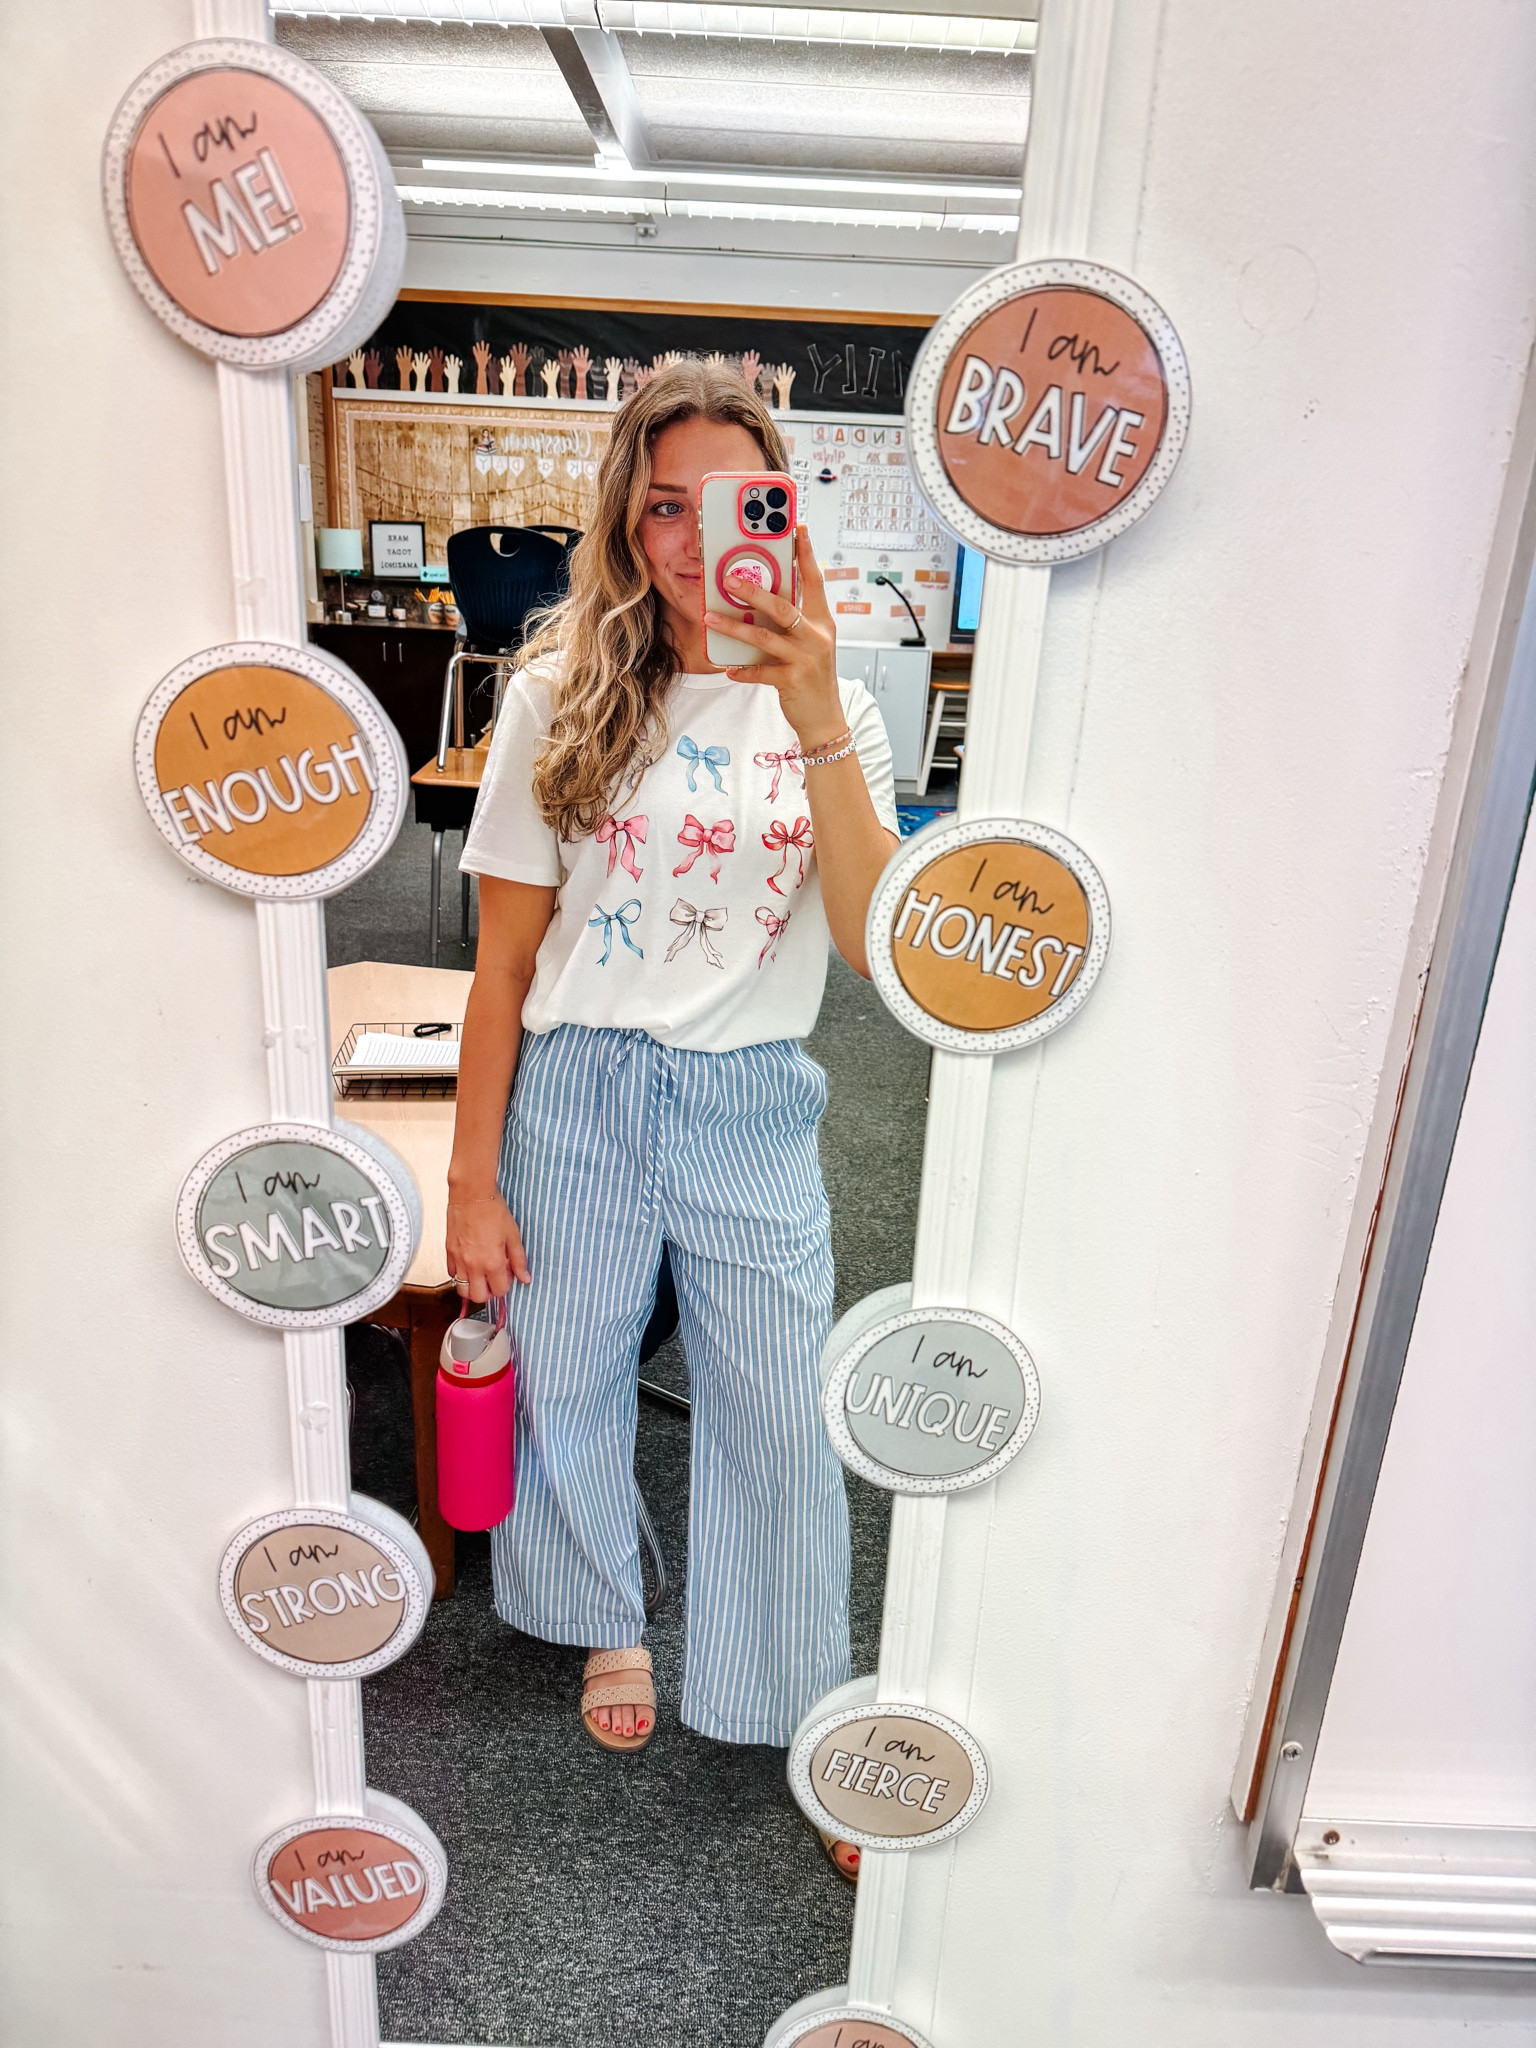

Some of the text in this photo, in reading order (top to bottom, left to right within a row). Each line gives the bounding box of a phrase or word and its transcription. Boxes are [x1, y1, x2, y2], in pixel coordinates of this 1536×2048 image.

[157, 111, 257, 179] I am
[181, 147, 303, 276] ME!
[1019, 307, 1120, 376] I am
[944, 354, 1145, 488] BRAVE
[190, 707, 286, 749] I am
[161, 733, 379, 845] ENOUGH
[969, 858, 1055, 915] I am
[892, 887, 1086, 997] HONEST
[235, 1171, 320, 1203] I am
[204, 1195, 390, 1279] SMART
[911, 1335, 988, 1378] I am
[844, 1371, 1011, 1451] UNIQUE
[264, 1545, 338, 1572] I am
[240, 1563, 409, 1634] STRONG
[865, 1726, 935, 1762] I am
[821, 1749, 950, 1814] FIERCE
[271, 1860, 425, 1915] VALUED
[295, 1850, 365, 1871] I am
[834, 2027, 843, 2048] I
